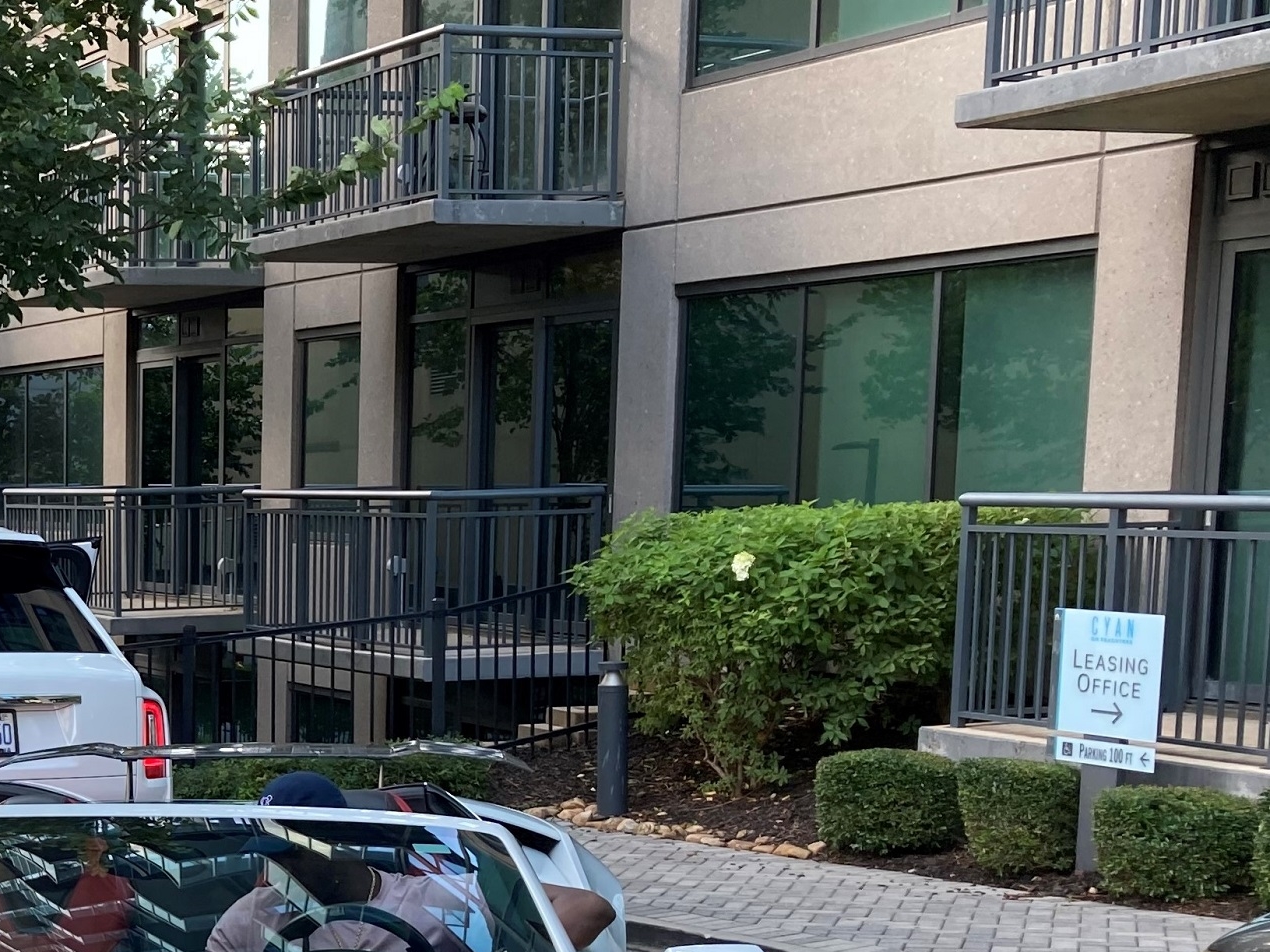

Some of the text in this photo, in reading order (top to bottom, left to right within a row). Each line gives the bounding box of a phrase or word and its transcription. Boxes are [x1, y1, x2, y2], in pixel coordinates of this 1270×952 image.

[1091, 615, 1135, 638] CYAN
[1073, 648, 1149, 676] LEASING
[1077, 673, 1141, 700] OFFICE
[1079, 743, 1133, 765] PARKING 100 FT
